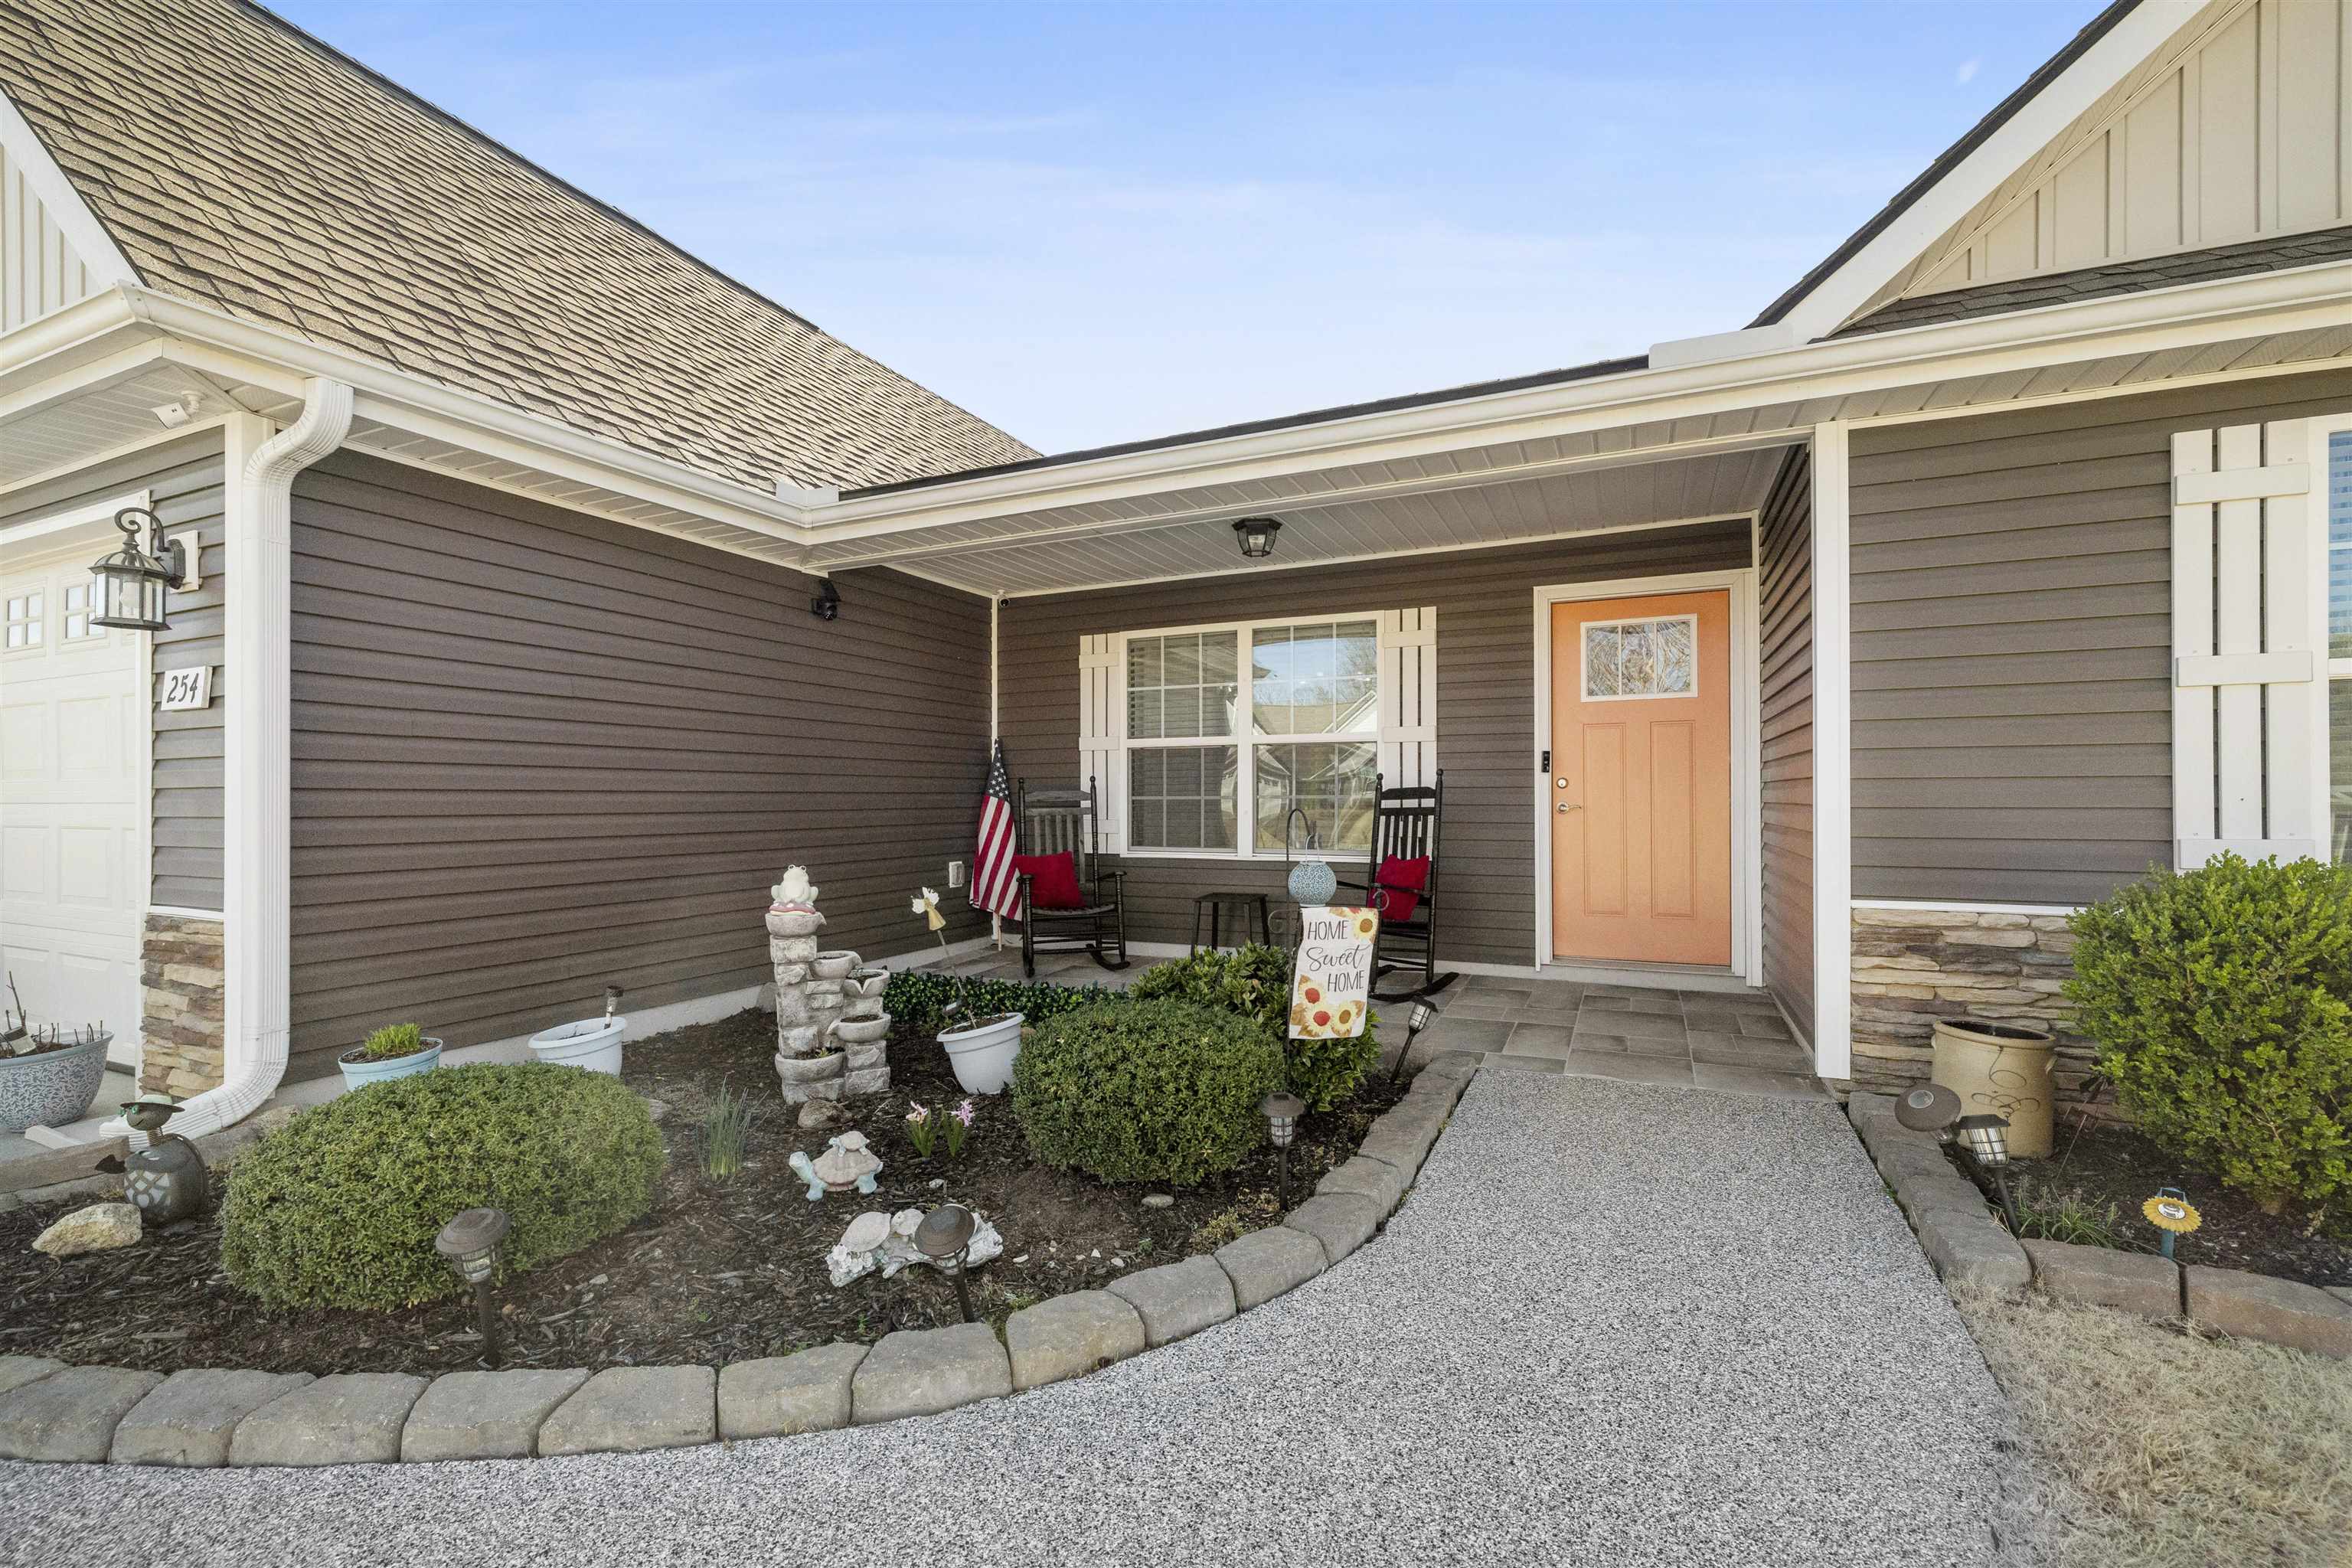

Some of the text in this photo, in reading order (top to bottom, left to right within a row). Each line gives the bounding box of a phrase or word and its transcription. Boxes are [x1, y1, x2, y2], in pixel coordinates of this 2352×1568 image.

[167, 673, 199, 703] 254
[1307, 920, 1349, 940] HOME
[1306, 945, 1370, 972] Sweet
[1328, 970, 1365, 992] HOME
